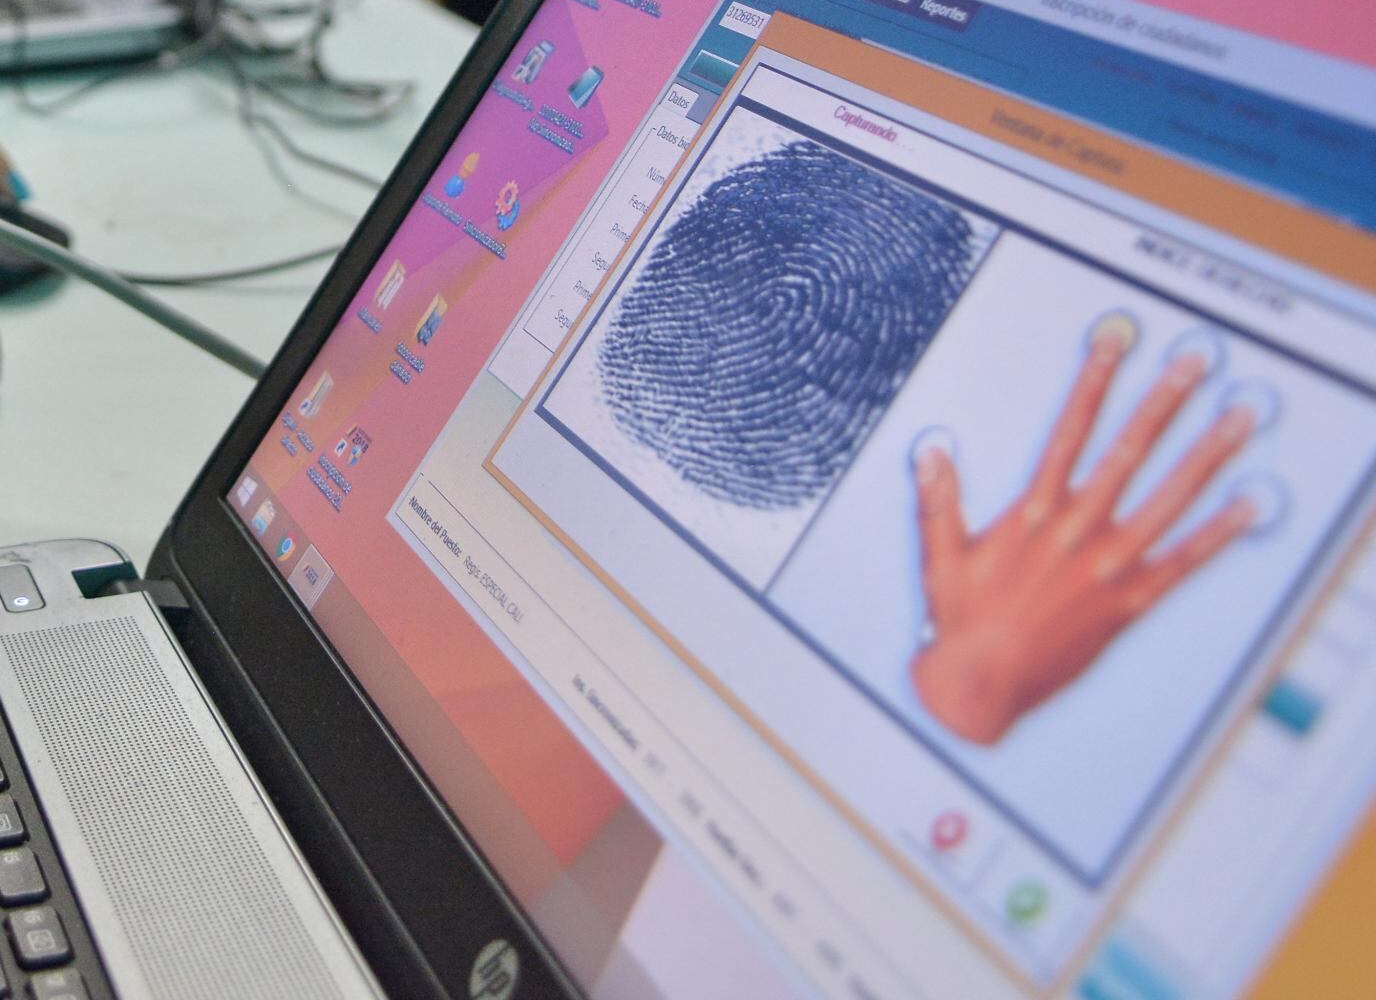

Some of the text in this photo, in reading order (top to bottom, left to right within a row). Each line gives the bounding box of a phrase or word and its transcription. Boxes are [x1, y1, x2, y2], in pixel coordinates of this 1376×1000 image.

[726, 5, 764, 28] 31269531
[667, 91, 690, 109] Datos
[656, 125, 679, 145] Datos
[408, 496, 432, 526] Nombre
[431, 519, 442, 535] del
[439, 528, 462, 557] Puesto:
